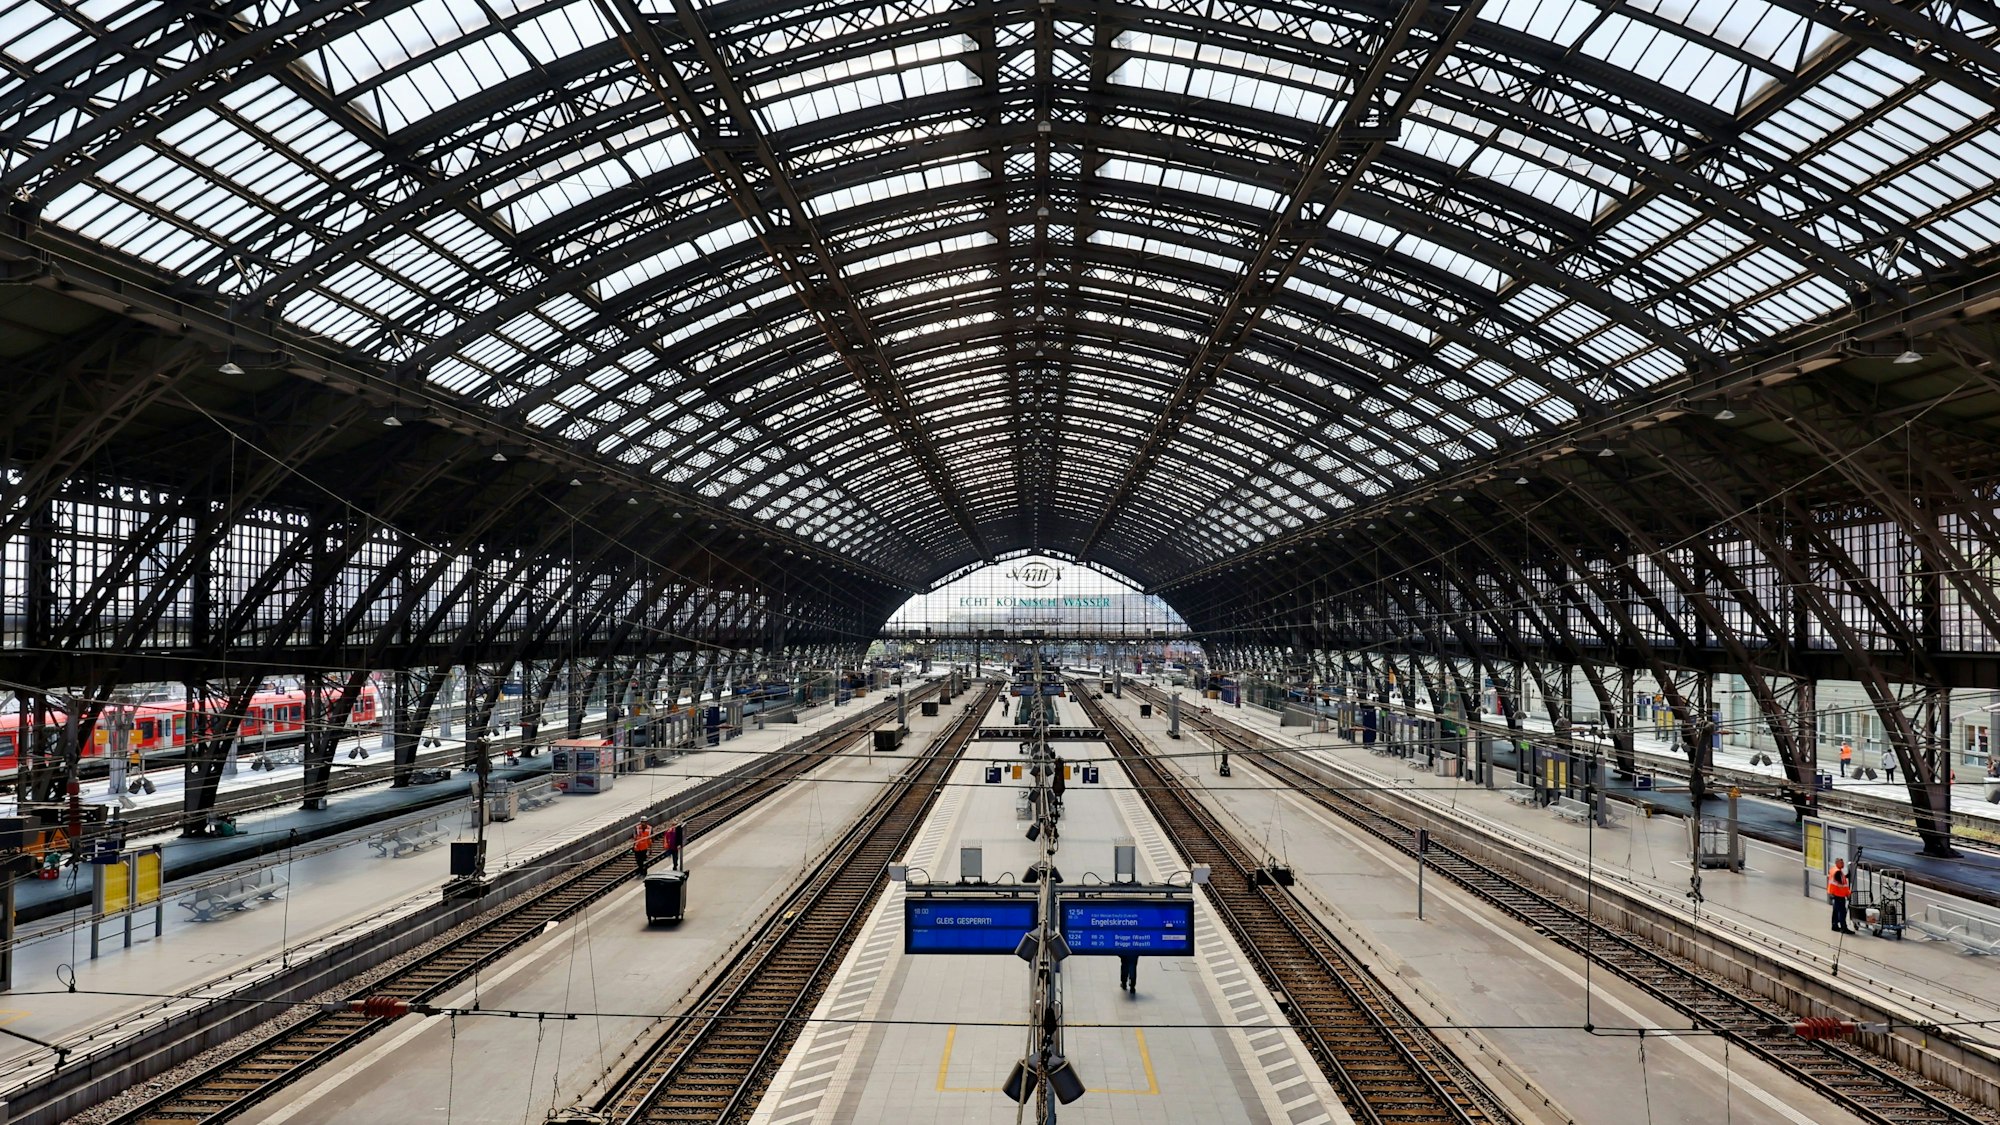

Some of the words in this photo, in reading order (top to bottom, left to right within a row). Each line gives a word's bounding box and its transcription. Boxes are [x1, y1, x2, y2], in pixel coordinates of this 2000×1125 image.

[1022, 568, 1048, 581] 4711
[960, 597, 989, 607] ECHT
[997, 596, 1056, 607] KÖLNISCH
[1063, 597, 1109, 607] WASSER
[704, 709, 709, 717] E
[987, 767, 995, 781] F
[1088, 767, 1097, 781] F
[1636, 774, 1644, 788] F
[1822, 775, 1831, 788] F
[94, 839, 107, 858] F
[936, 917, 954, 925] GLEIS
[956, 917, 992, 925] GESPERRT!
[1091, 918, 1138, 926] Engelskirchen
